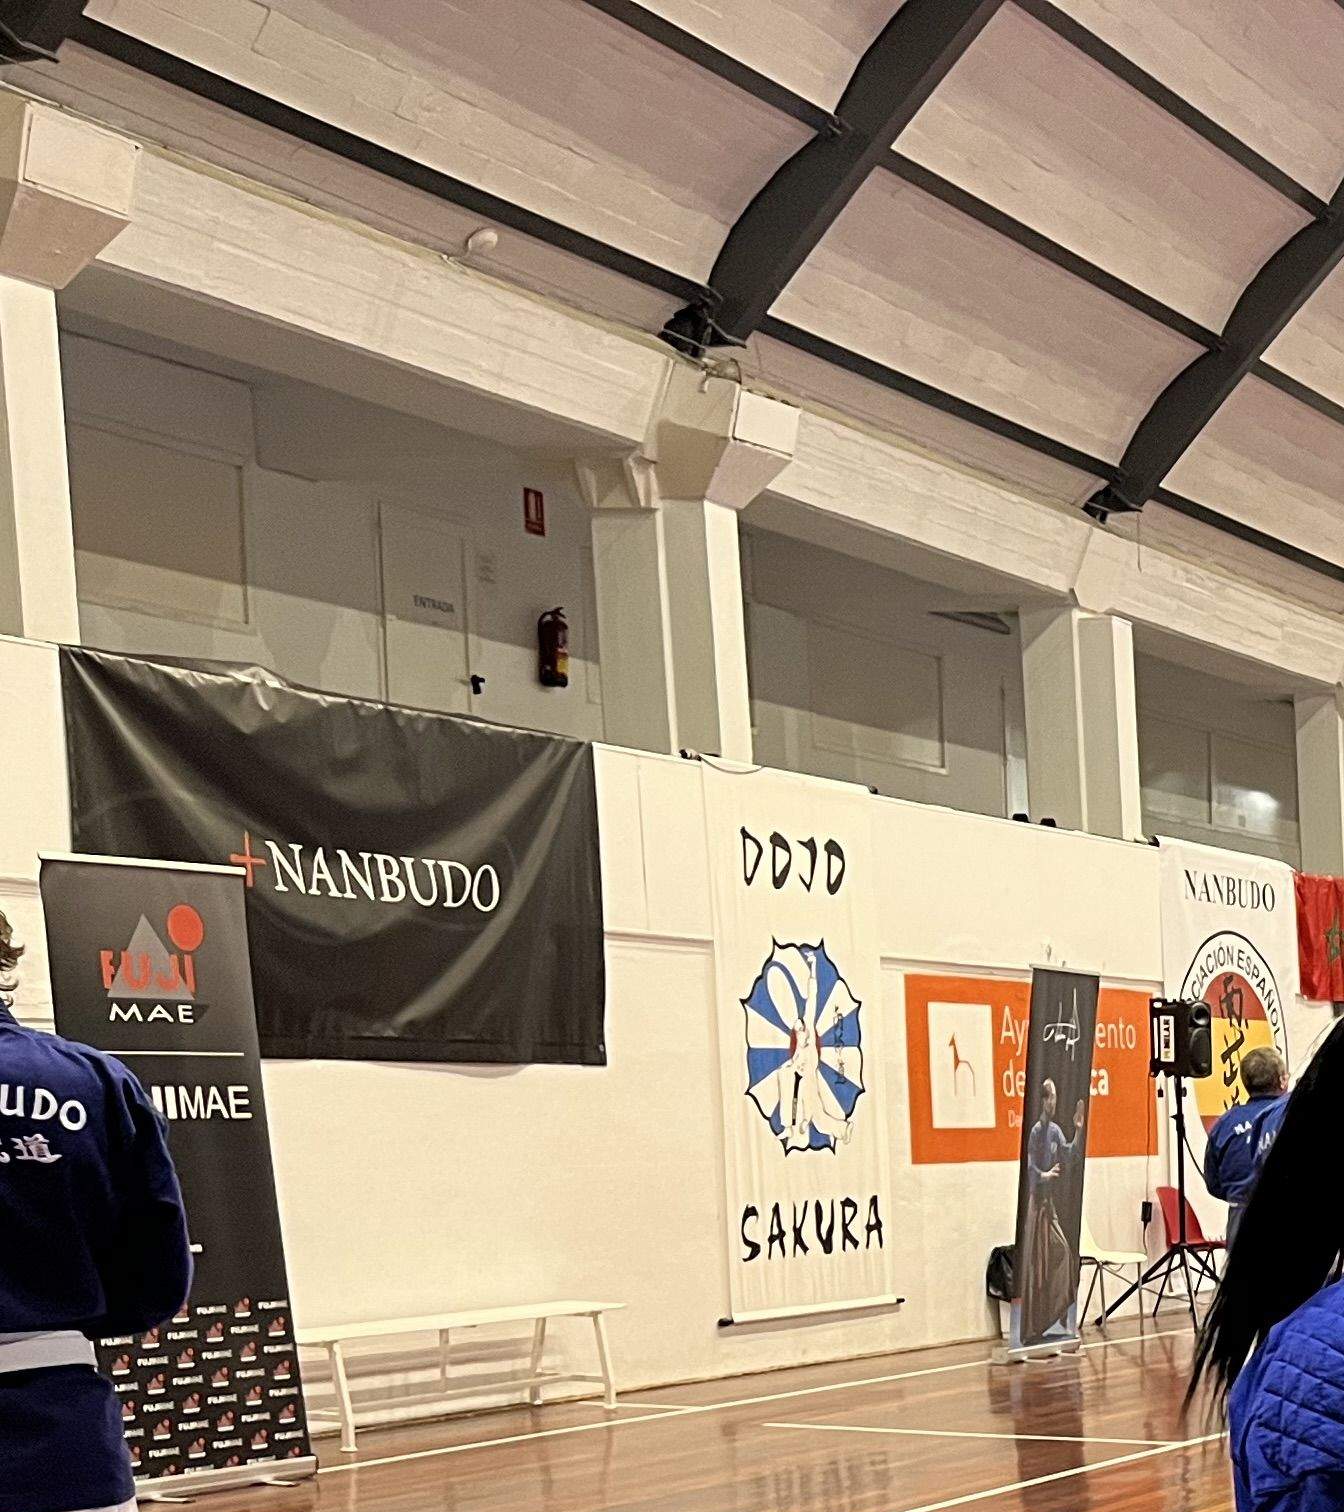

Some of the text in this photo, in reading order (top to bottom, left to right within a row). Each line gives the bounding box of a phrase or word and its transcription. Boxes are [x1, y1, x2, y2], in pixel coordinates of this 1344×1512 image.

[264, 839, 500, 913] NANBUDO
[740, 826, 845, 895] DOJO
[1184, 869, 1275, 912] NANBUDO
[100, 950, 195, 992] FUJI
[1237, 949, 1283, 1055] ESPAÑOL
[109, 1003, 194, 1023] MAE
[742, 1194, 884, 1262] SAKURA
